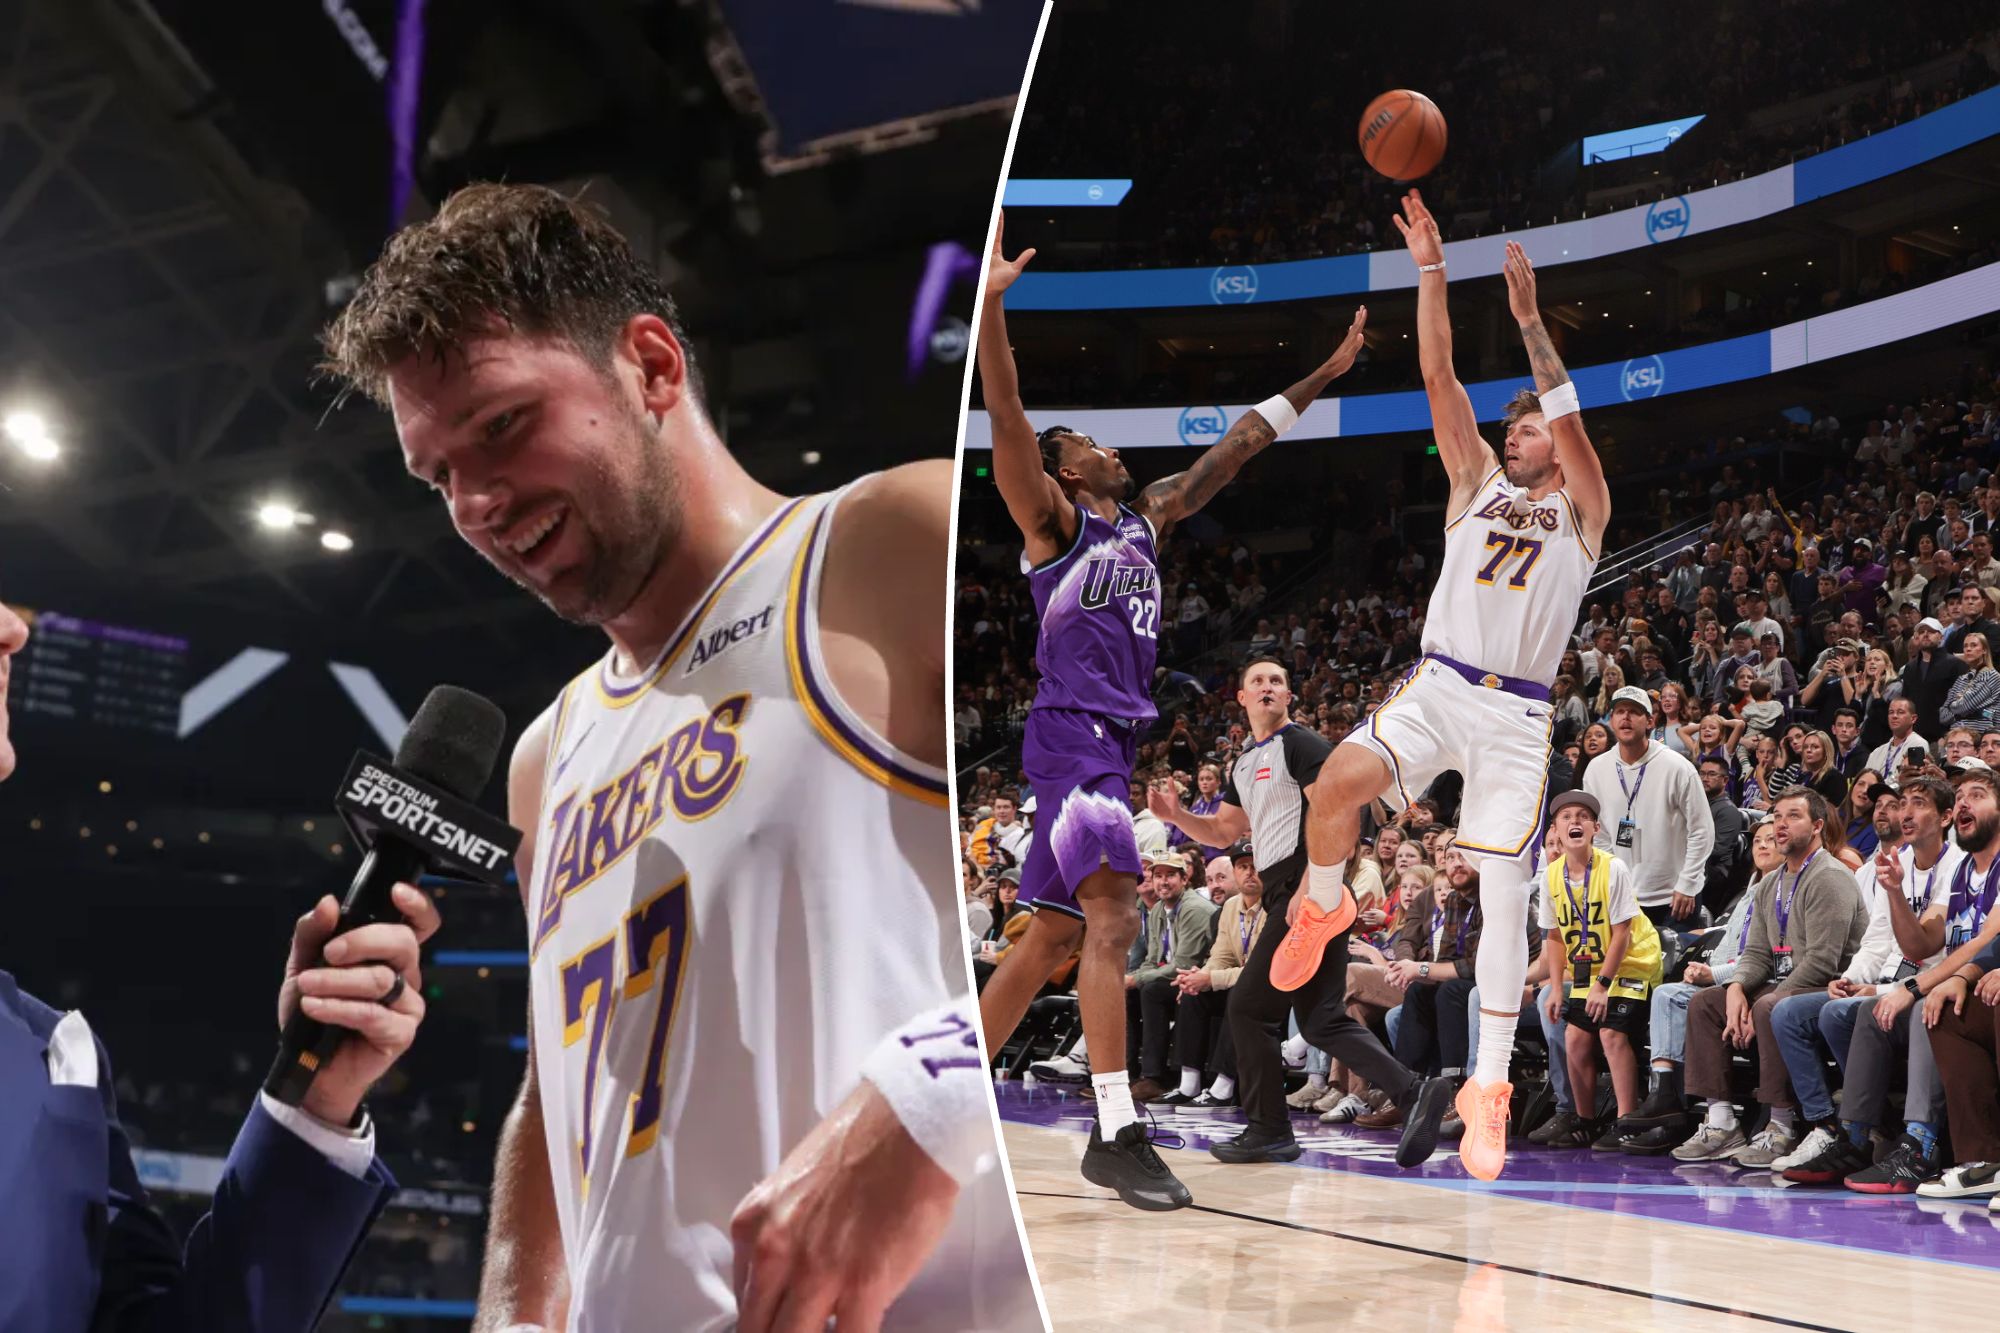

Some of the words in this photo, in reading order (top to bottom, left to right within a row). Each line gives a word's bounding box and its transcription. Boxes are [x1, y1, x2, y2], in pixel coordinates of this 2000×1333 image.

[1652, 208, 1686, 232] KSL
[1216, 276, 1257, 294] KSL
[1627, 367, 1662, 390] KSL
[1185, 417, 1224, 434] KSL
[1475, 530, 1543, 592] 77
[686, 605, 774, 672] Albert
[1128, 596, 1158, 639] 22
[360, 764, 438, 811] SPECTRUM
[346, 778, 508, 870] SPORTSNET
[532, 691, 752, 964] LAKERS
[1565, 930, 1605, 964] 23
[559, 872, 692, 1206] 77
